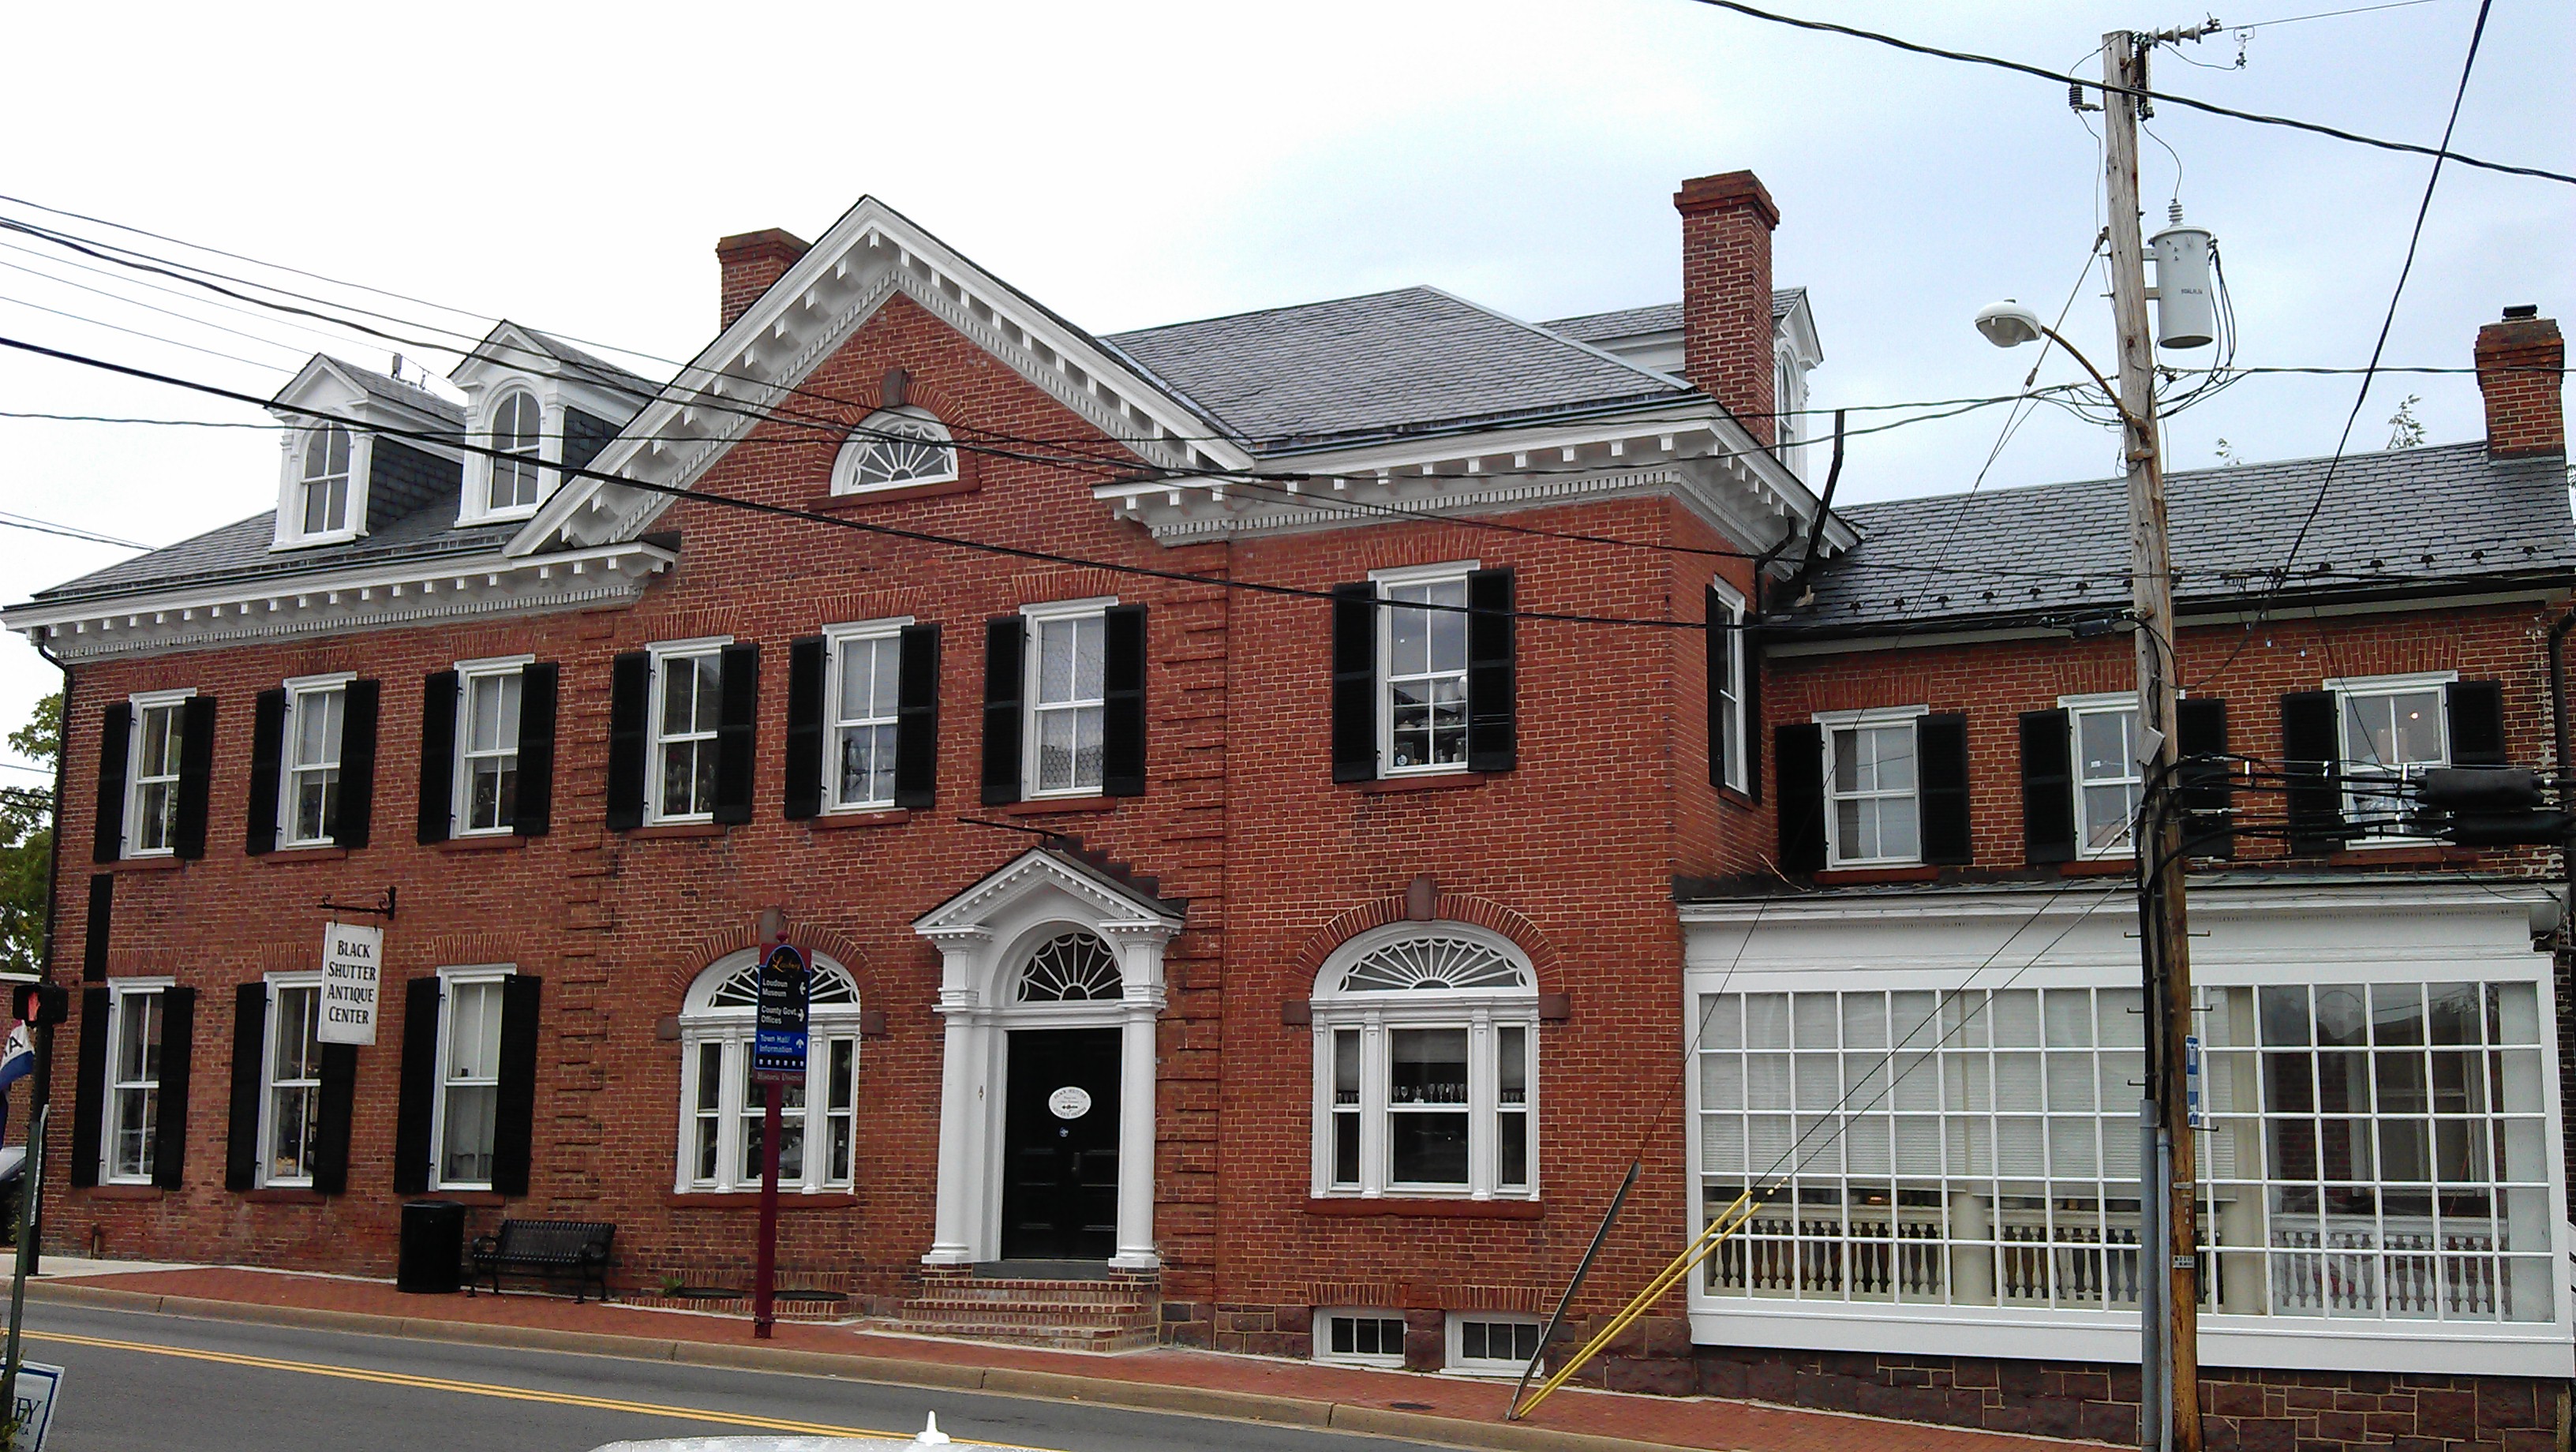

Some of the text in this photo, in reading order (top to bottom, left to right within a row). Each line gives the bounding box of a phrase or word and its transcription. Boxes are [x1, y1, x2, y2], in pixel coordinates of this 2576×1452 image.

[337, 940, 371, 959] BLACK
[328, 961, 376, 981] SHUTTER
[762, 978, 788, 987] Loudoun
[327, 984, 374, 1004] ANTIQUE
[762, 987, 787, 997] Museum
[328, 1005, 369, 1024] CENTER
[762, 1005, 781, 1016] County
[761, 1015, 782, 1024] Offices
[760, 1034, 775, 1042] Town
[759, 1044, 793, 1053] Information
